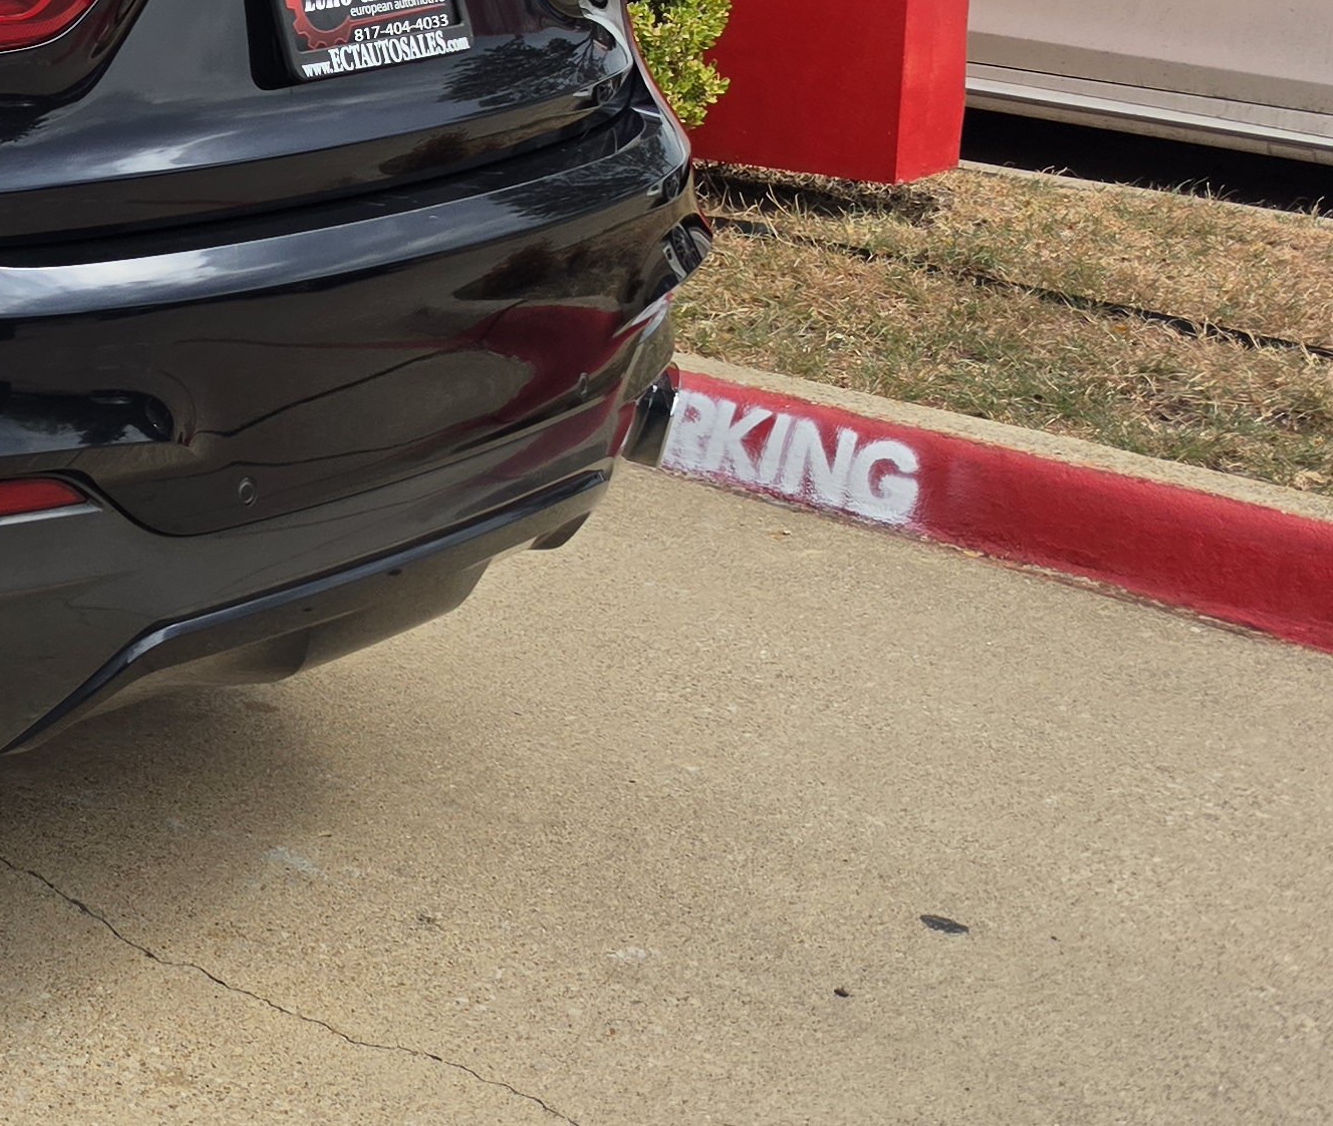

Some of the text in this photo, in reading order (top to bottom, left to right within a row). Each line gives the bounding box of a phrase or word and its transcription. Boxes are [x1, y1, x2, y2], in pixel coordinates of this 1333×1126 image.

[350, 0, 393, 17] european
[354, 13, 449, 42] 817-404-4033
[302, 29, 471, 78] www.ECTAUTOSALES.com
